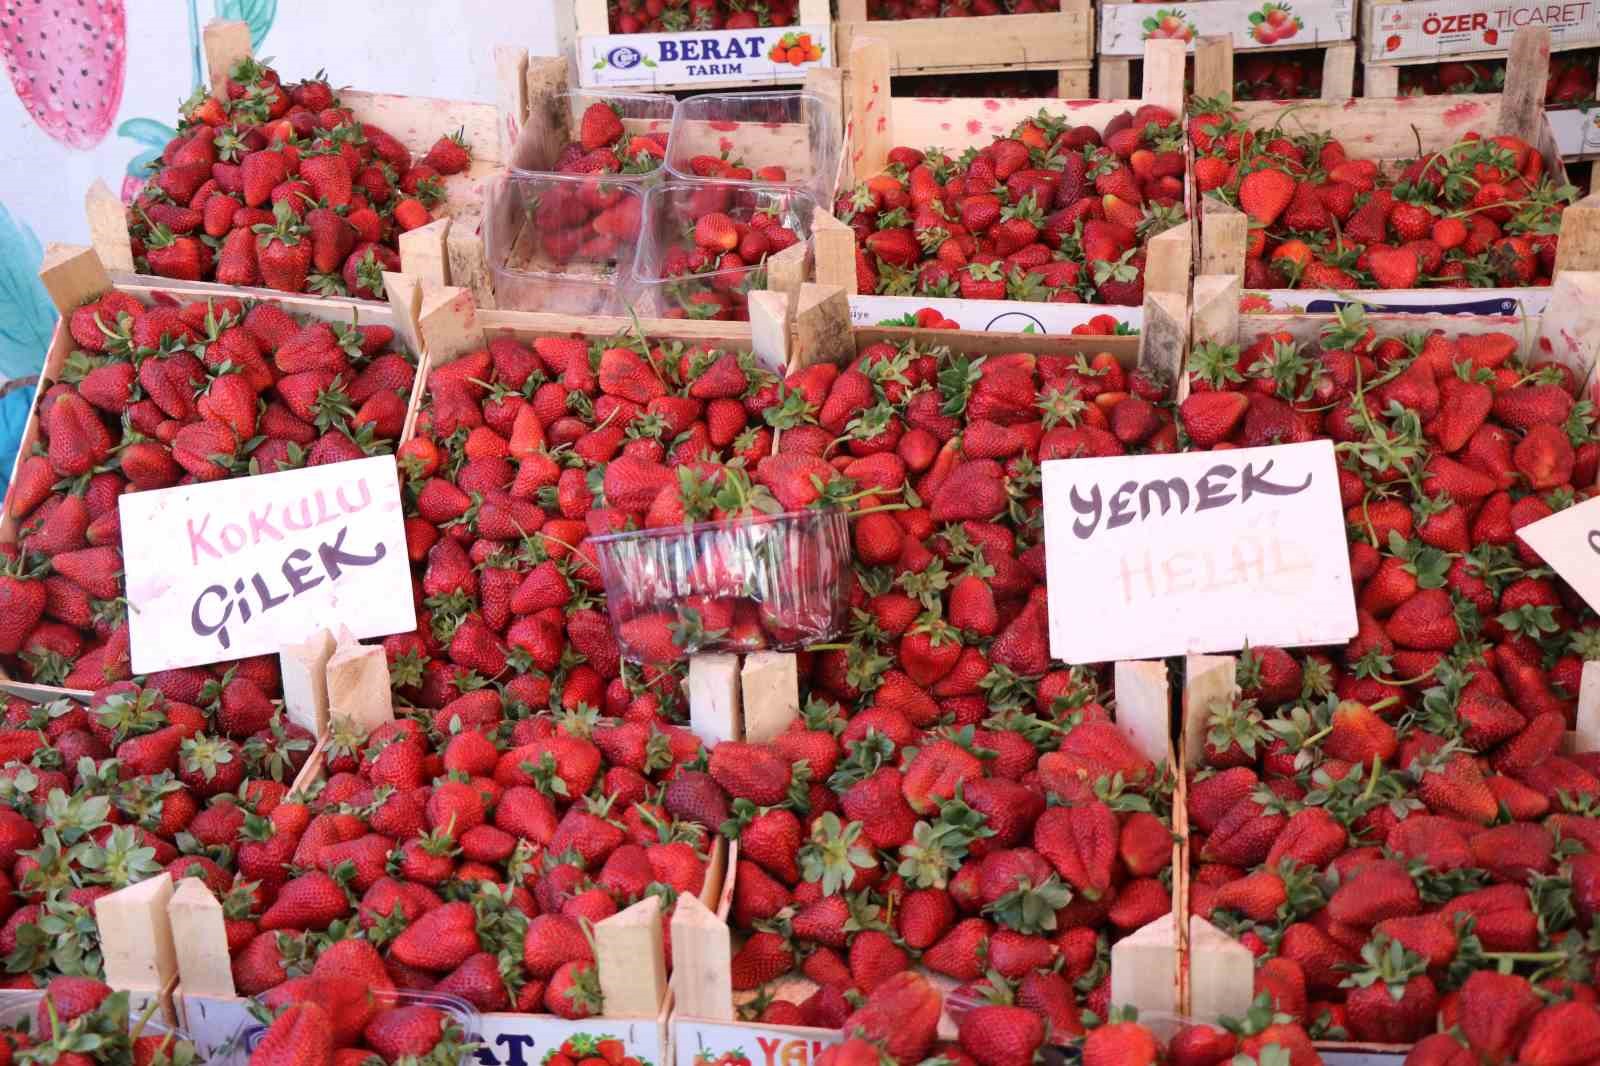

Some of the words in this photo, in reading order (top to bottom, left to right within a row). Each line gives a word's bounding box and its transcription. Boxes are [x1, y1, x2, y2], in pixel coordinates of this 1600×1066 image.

[1422, 12, 1488, 35] ÖZER
[658, 36, 765, 62] BERAT
[686, 63, 742, 76] TARIM
[1069, 459, 1313, 540] YEMEK
[186, 478, 372, 566] KOKULU
